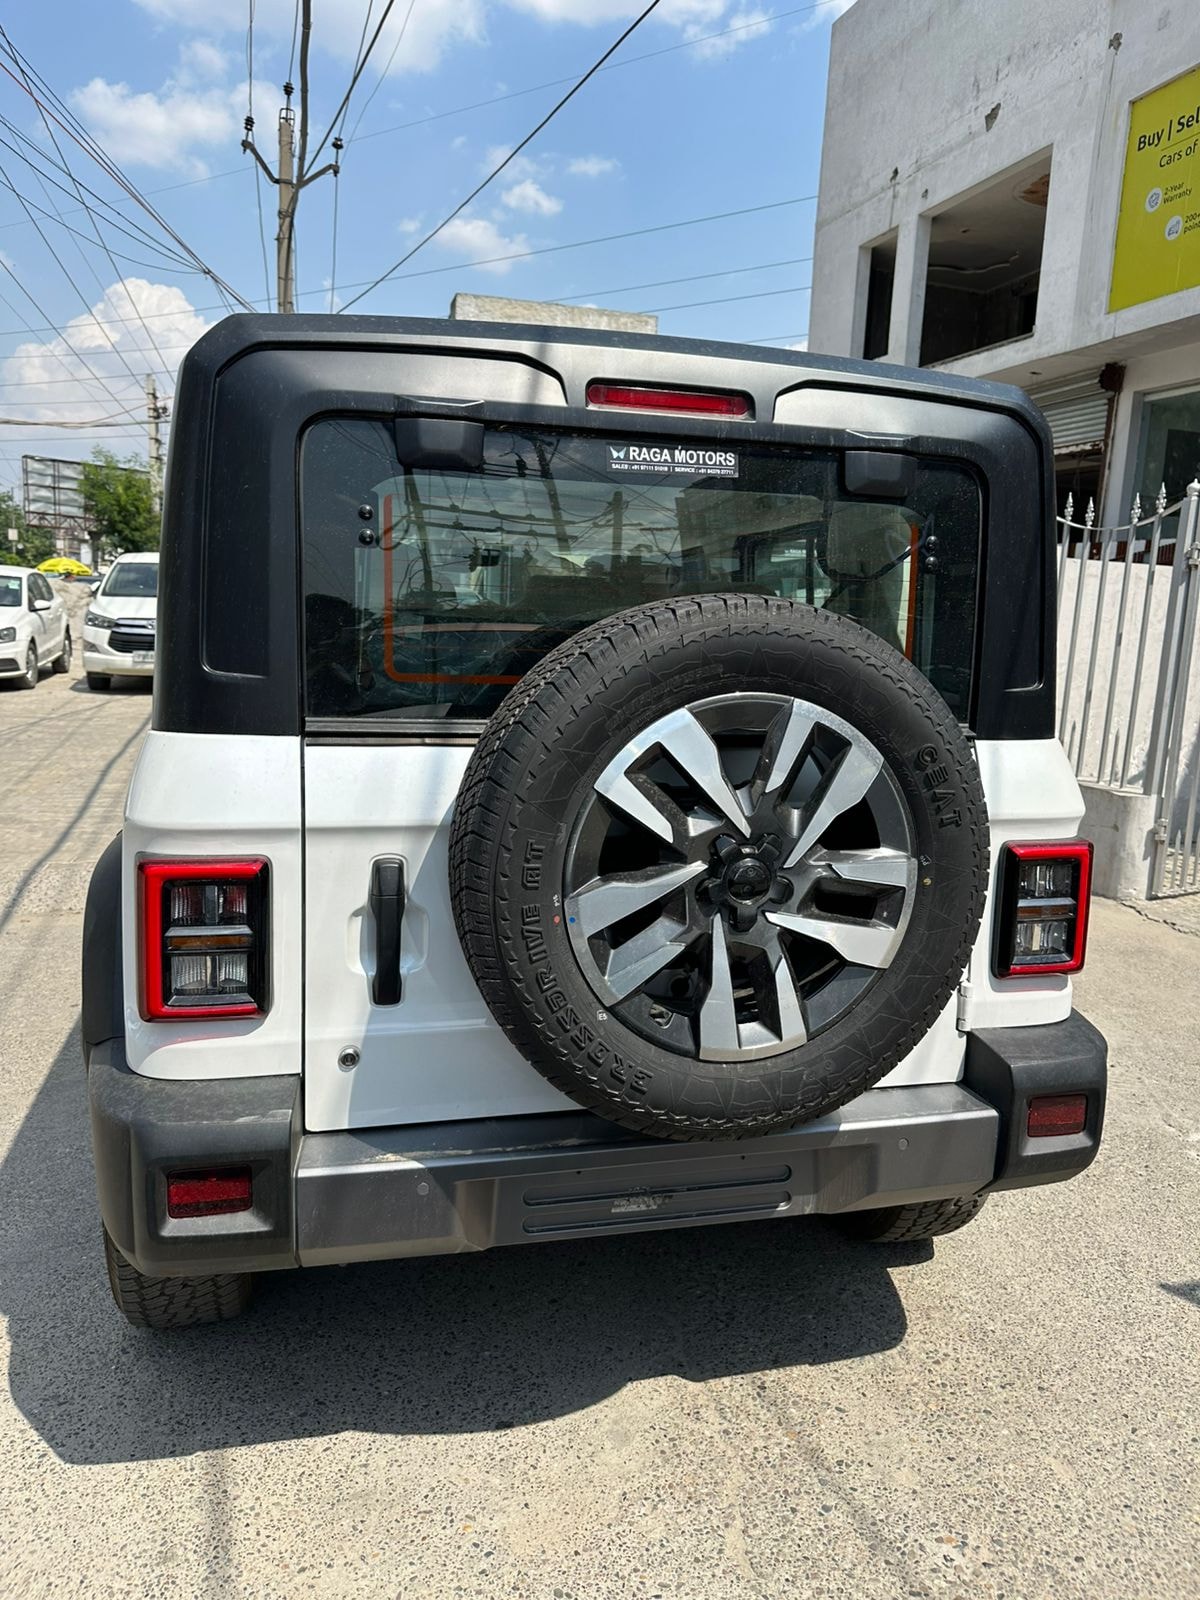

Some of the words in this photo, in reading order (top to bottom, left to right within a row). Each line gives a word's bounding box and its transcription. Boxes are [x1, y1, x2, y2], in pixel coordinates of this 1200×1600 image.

[1137, 128, 1165, 152] Buy
[1176, 105, 1200, 133] Sel
[1159, 149, 1183, 168] Cars
[1185, 138, 1199, 156] of
[1163, 187, 1193, 205] Warranty
[1164, 181, 1185, 196] 2-Year
[629, 446, 672, 463] RAGA
[674, 449, 736, 466] MOTORS
[916, 743, 962, 829] CEAT
